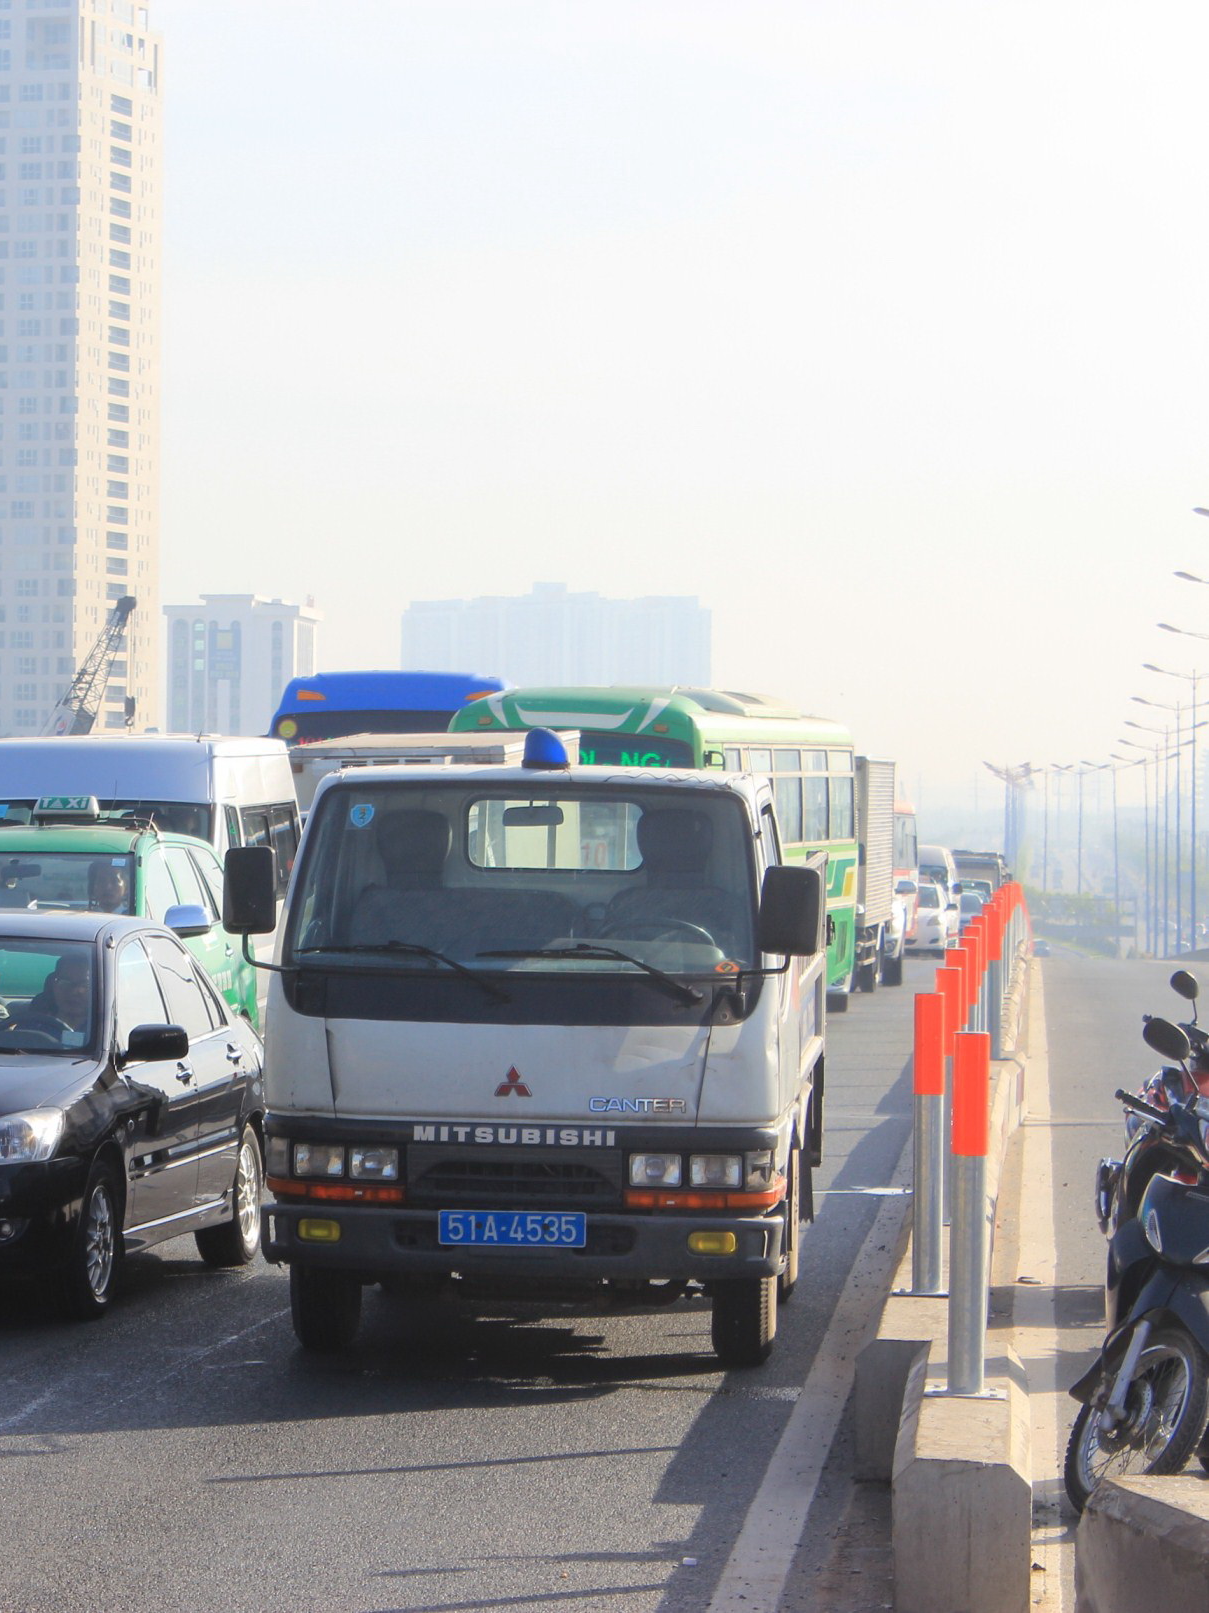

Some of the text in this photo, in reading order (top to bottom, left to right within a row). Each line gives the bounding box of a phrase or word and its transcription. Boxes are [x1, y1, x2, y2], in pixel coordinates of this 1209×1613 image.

[41, 797, 88, 809] TAXI
[589, 1097, 686, 1113] CANTER
[413, 1125, 616, 1147] MITSUBISHI
[447, 1214, 578, 1243] 51A-4535
